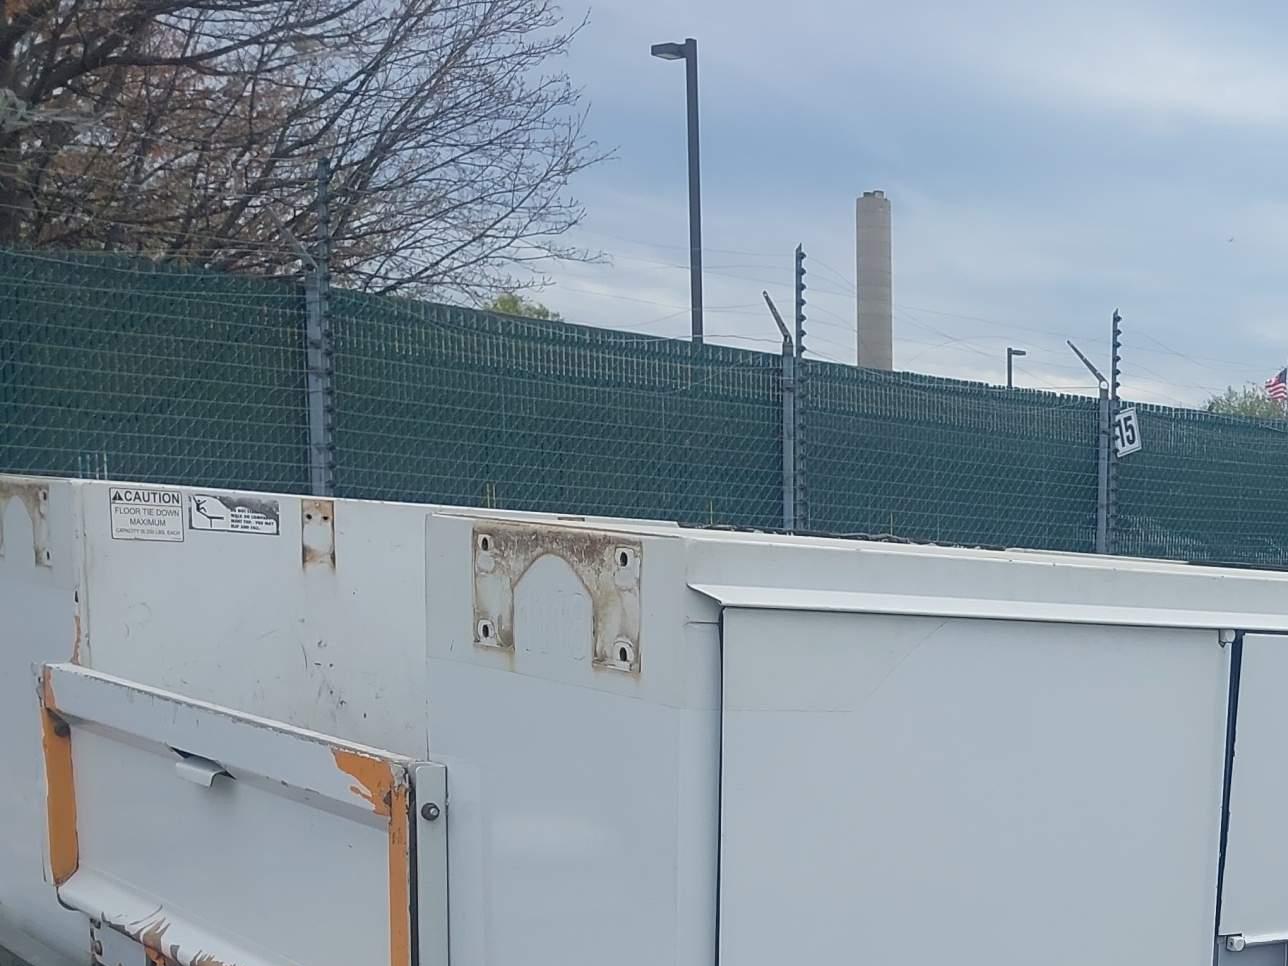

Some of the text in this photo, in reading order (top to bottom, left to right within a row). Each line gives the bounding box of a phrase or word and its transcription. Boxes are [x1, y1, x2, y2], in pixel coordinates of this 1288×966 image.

[124, 490, 180, 504] CAUTION
[115, 507, 180, 517] FLOOR TIE DOWN
[129, 518, 167, 527] MAXIMUM
